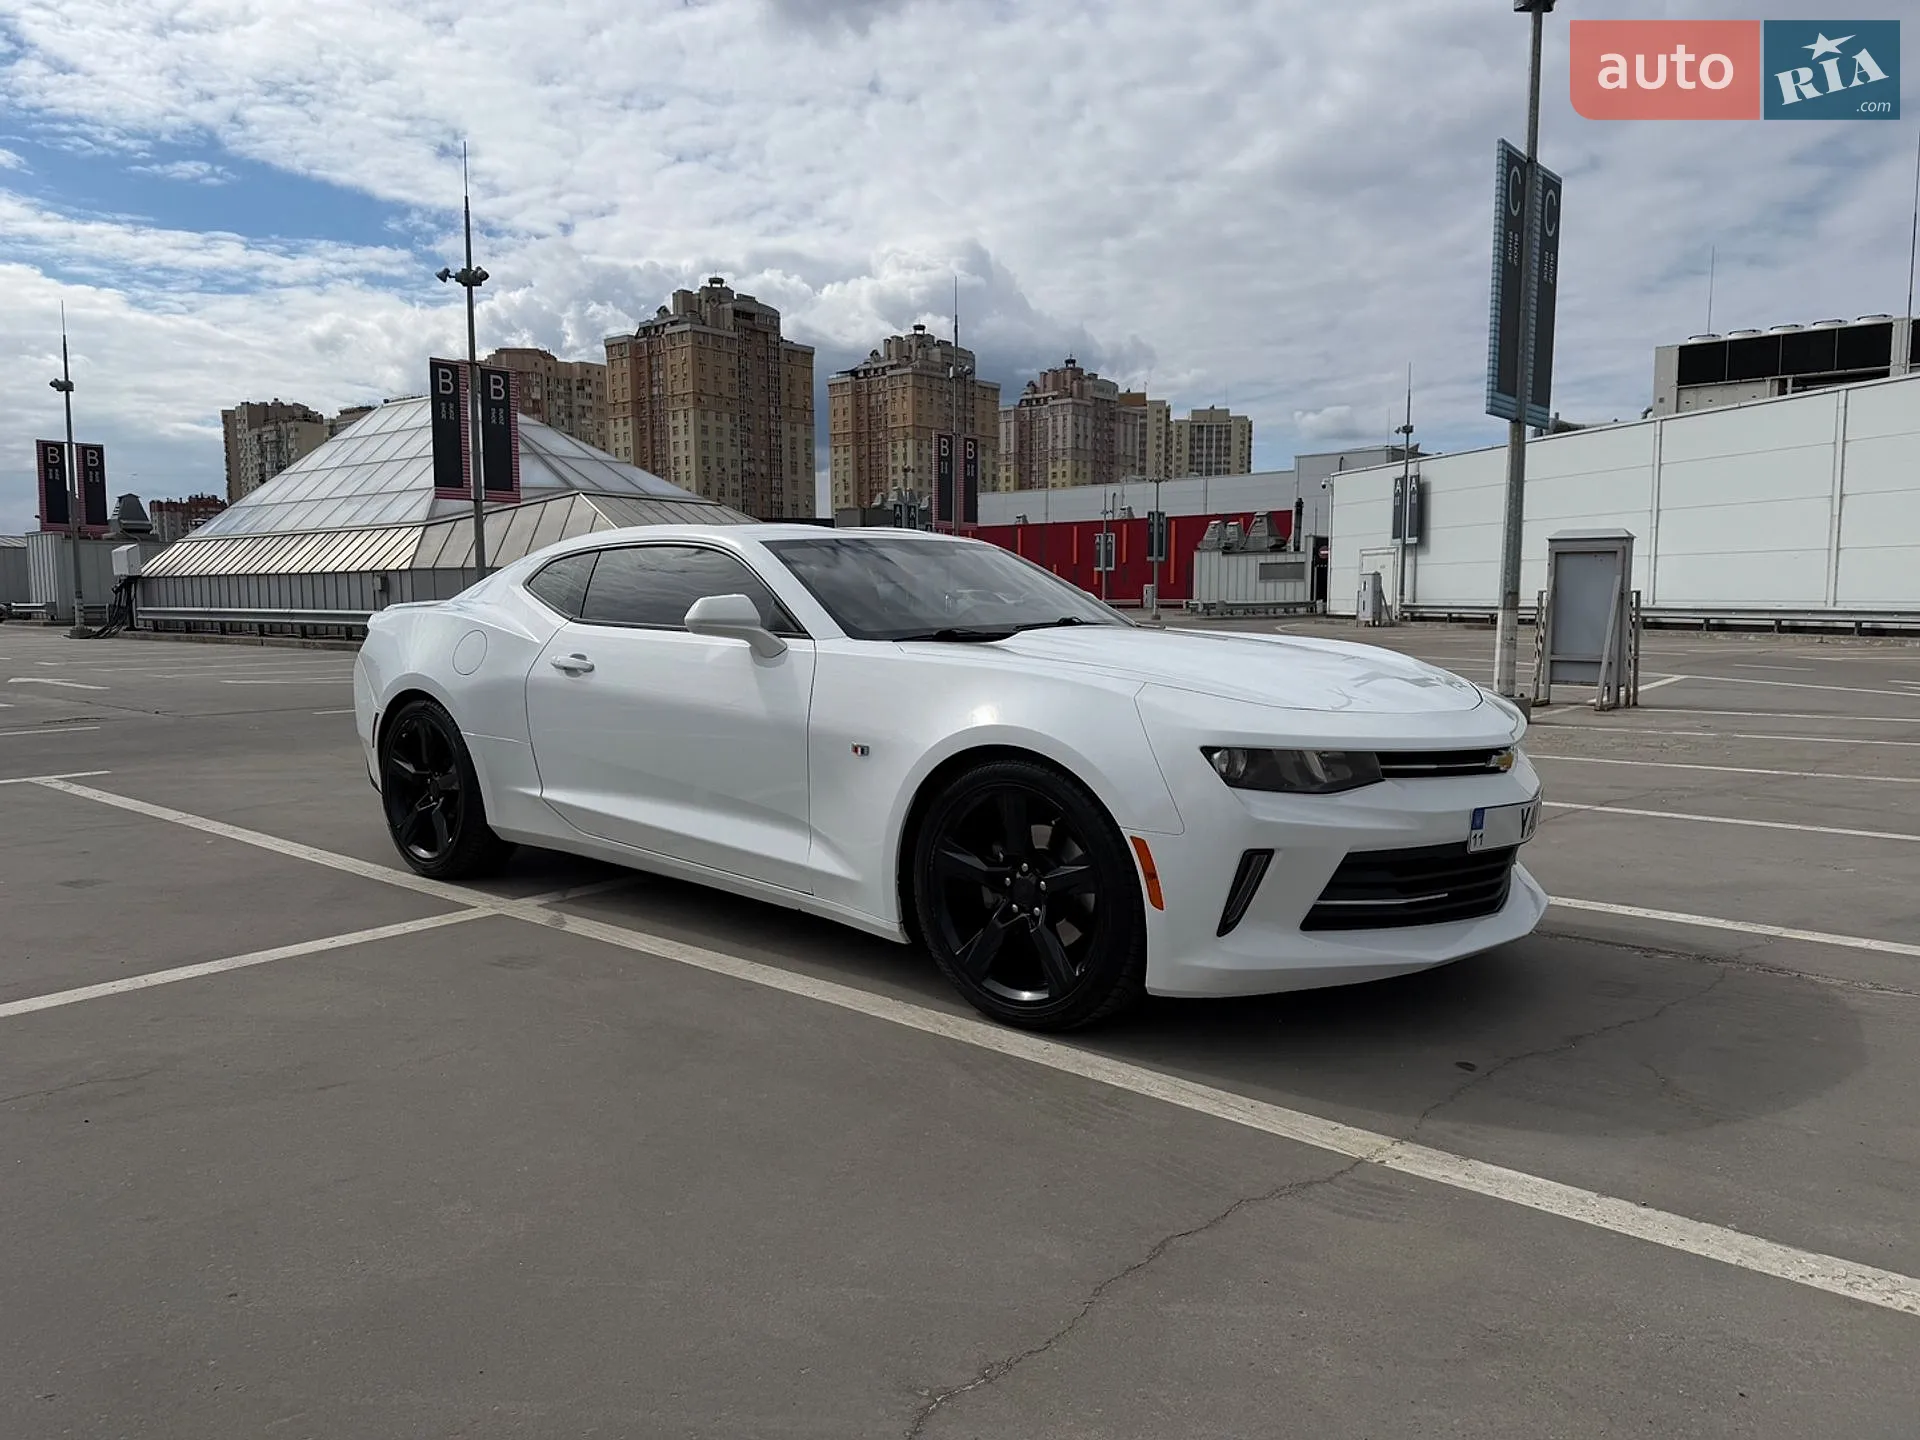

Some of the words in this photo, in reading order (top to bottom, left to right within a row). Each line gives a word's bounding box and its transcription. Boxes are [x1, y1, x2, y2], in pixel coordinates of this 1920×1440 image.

[1509, 165, 1521, 217] C
[1545, 188, 1556, 237] C
[438, 367, 454, 395] B
[489, 374, 505, 400] B
[47, 446, 60, 464] B
[940, 437, 949, 457] B
[966, 441, 975, 460] B
[86, 449, 99, 467] B
[1395, 479, 1402, 493] A
[1410, 477, 1418, 491] A
[1472, 833, 1483, 847] 11
